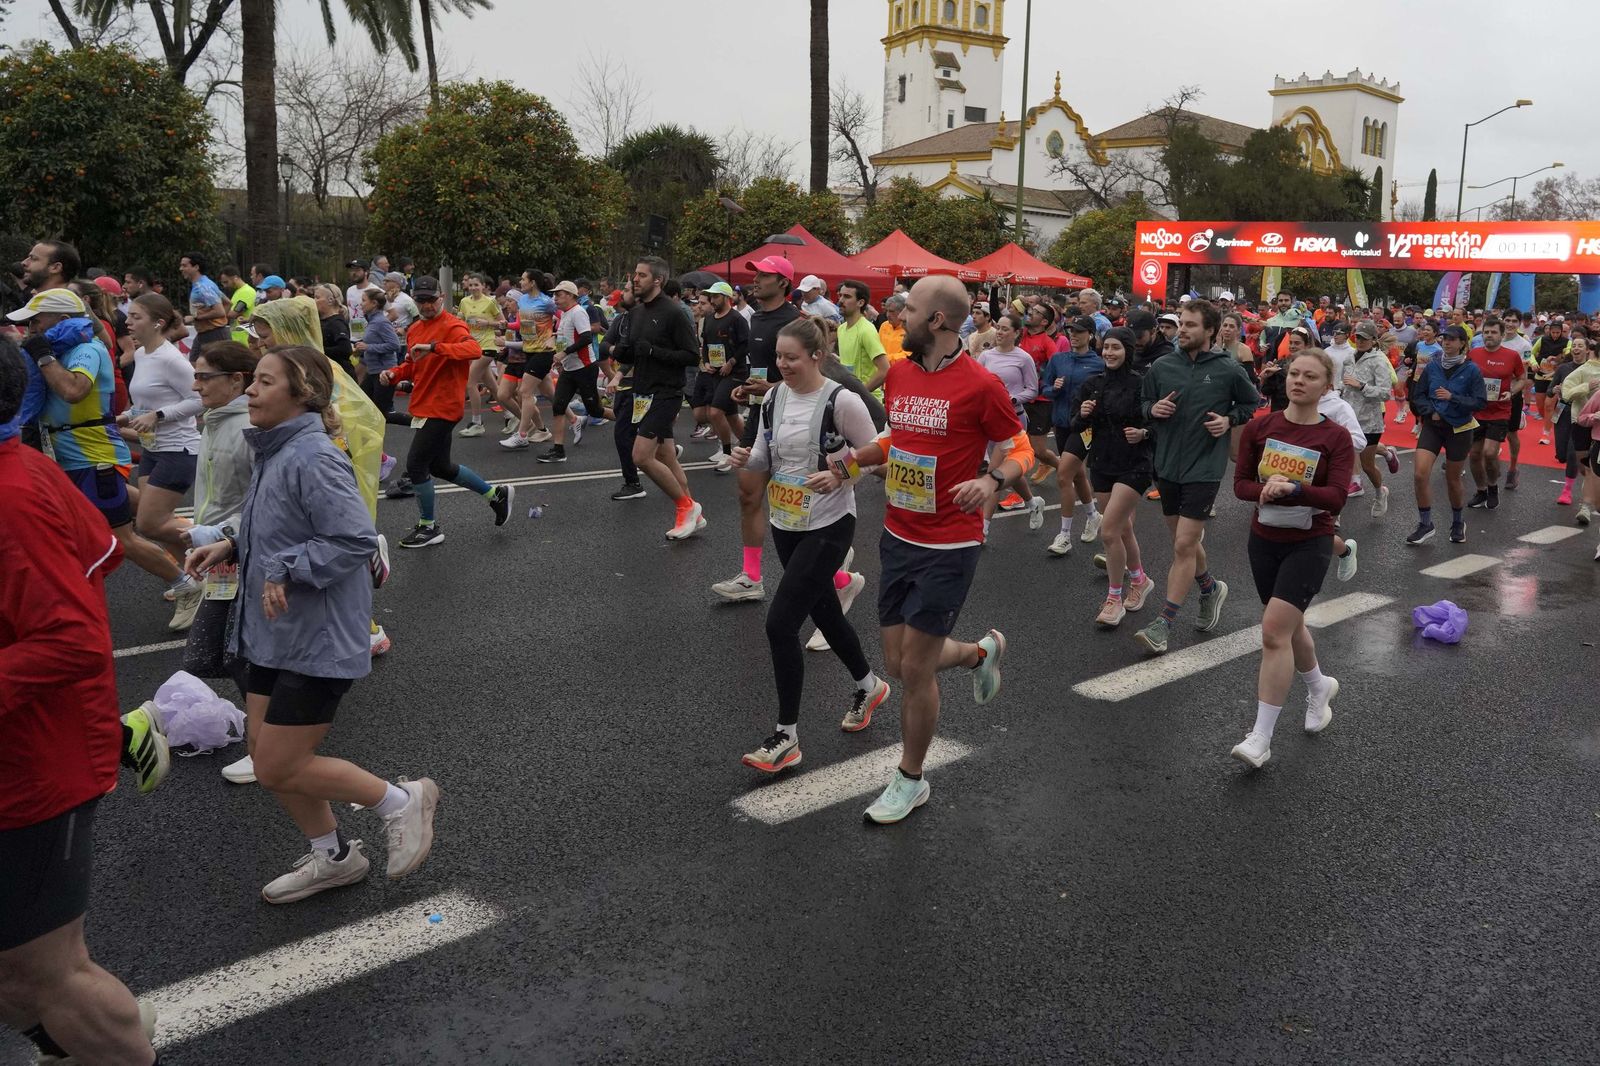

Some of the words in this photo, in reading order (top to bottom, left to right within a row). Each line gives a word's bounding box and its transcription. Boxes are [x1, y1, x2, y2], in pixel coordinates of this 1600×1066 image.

[1216, 238, 1253, 248] Sprinter
[1293, 237, 1338, 252] HOKA
[1409, 231, 1482, 246] maratón
[1424, 242, 1481, 258] sevilla
[904, 396, 950, 410] LEUKAEMIA
[903, 405, 909, 413] &
[910, 405, 947, 419] MYELOMA
[904, 424, 914, 432] that
[930, 428, 947, 436] lives
[933, 418, 946, 429] UK
[1265, 452, 1306, 475] 18899
[890, 462, 925, 487] 17233
[770, 483, 804, 506] 17232
